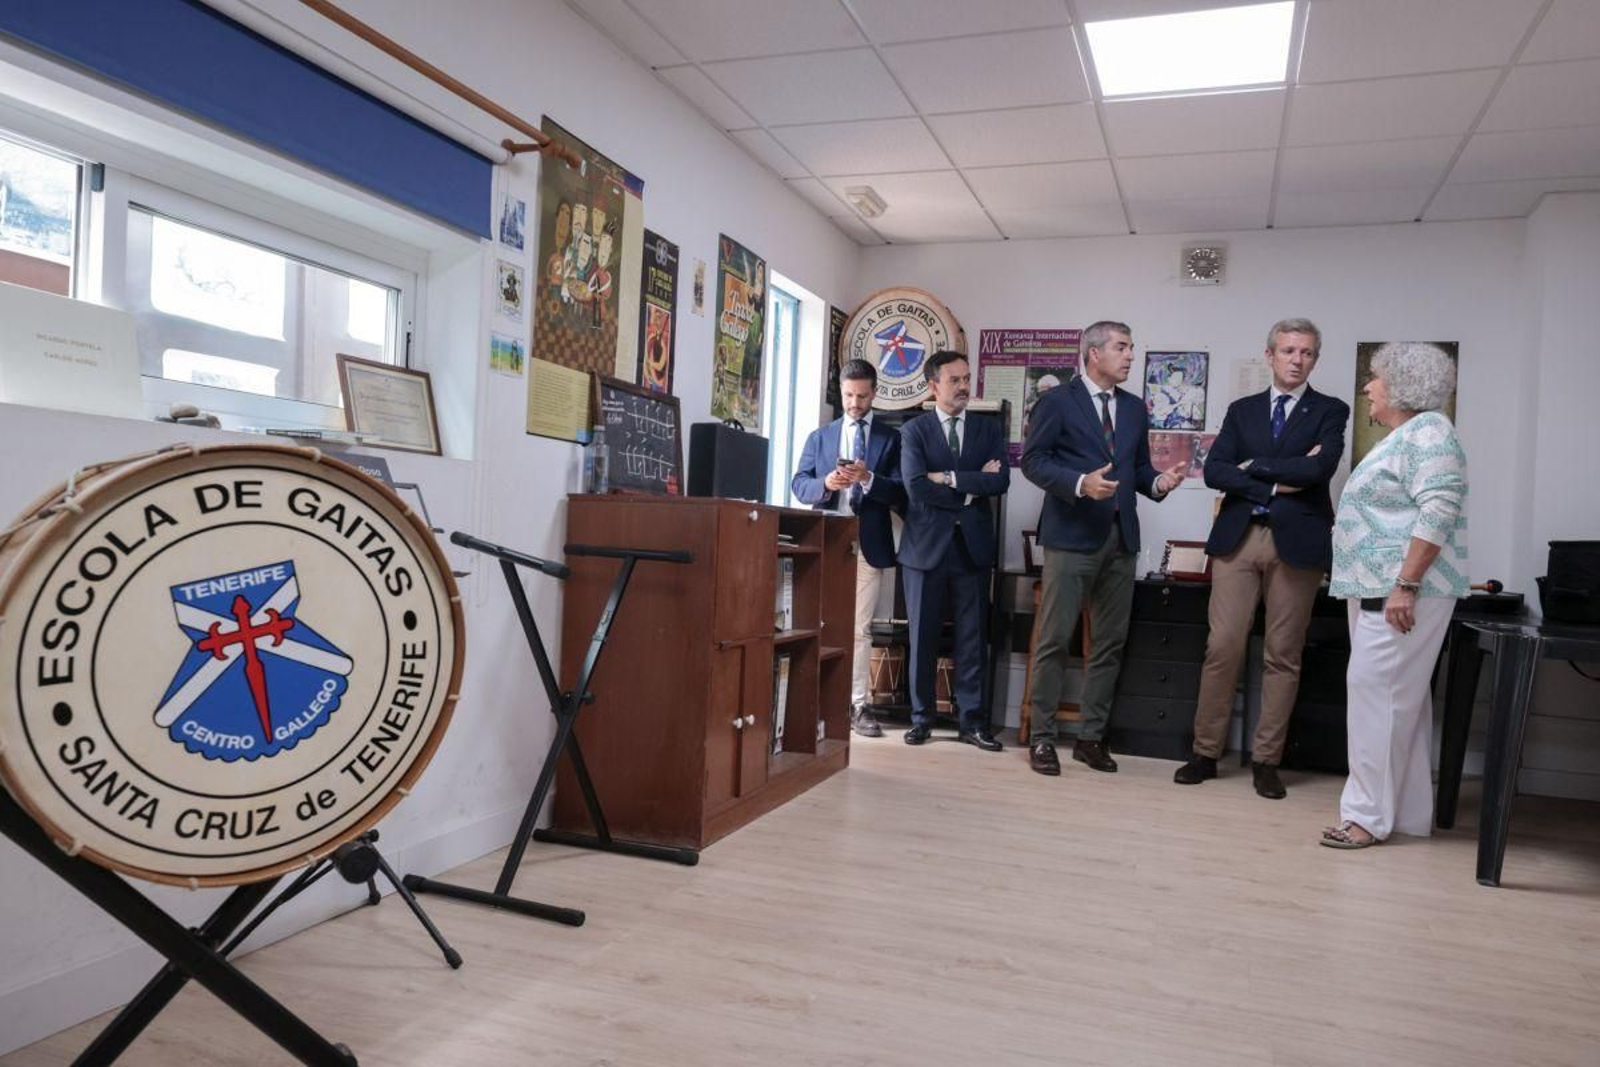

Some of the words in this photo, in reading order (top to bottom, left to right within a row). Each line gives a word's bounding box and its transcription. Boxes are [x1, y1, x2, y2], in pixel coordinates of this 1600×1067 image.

[854, 318, 876, 359] SCOLA
[877, 305, 894, 319] DE
[897, 303, 936, 327] GAITAS
[981, 331, 1002, 354] XIX
[1035, 331, 1079, 340] Internacional
[891, 386, 916, 398] CRUZ
[38, 503, 178, 688] ESCOLA
[193, 480, 264, 515] DE
[287, 486, 413, 598] GAITAS
[180, 565, 287, 600] TENERIFE
[181, 719, 256, 750] CENTRO
[274, 678, 338, 742] GALLEGO
[59, 734, 161, 829] SANTA
[174, 805, 281, 840] CRUZ
[295, 787, 338, 821] de
[340, 640, 428, 787] TENERIFE
